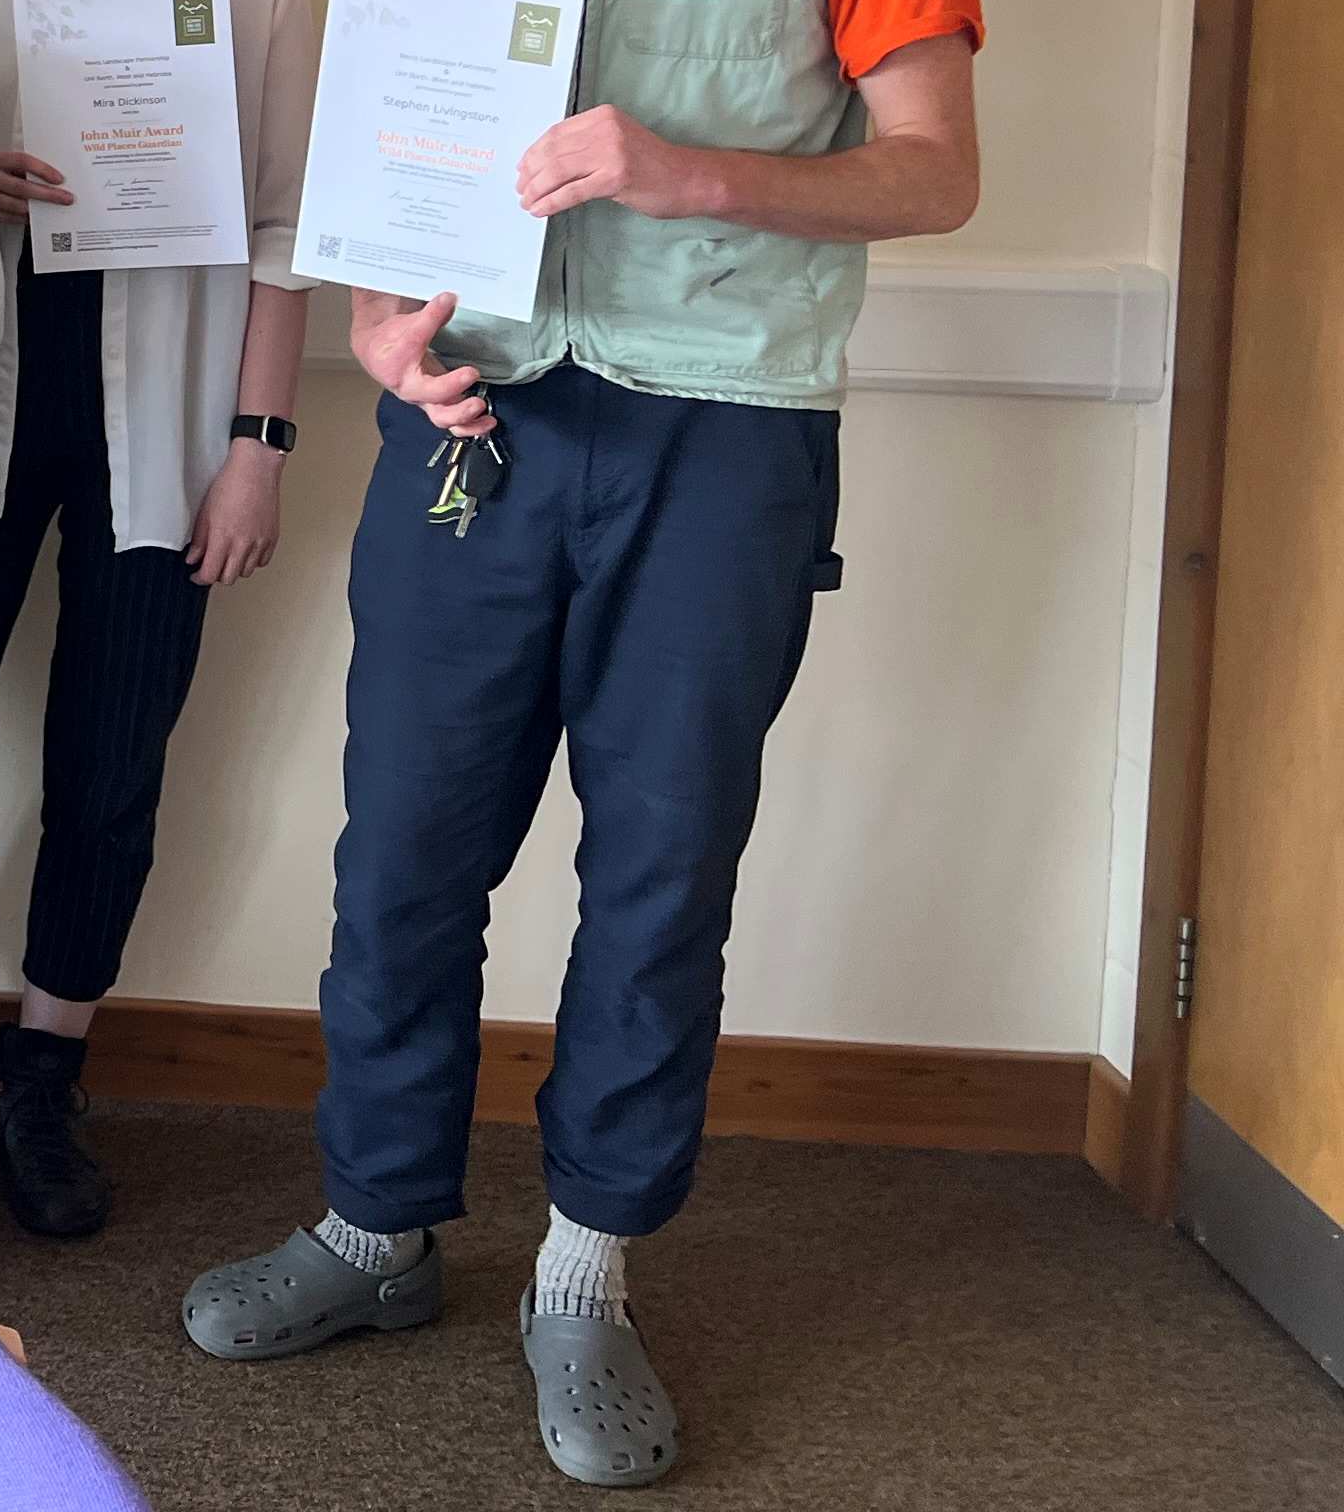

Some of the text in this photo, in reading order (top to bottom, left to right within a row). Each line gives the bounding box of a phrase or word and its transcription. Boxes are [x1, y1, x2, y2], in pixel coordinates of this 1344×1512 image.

[93, 95, 166, 107] Mira Dickinson
[382, 95, 500, 126] Stephen Livingstone
[80, 123, 183, 141] John Muir Award
[83, 138, 182, 151] Wild Places Guardian
[376, 128, 494, 160] John Muir Award
